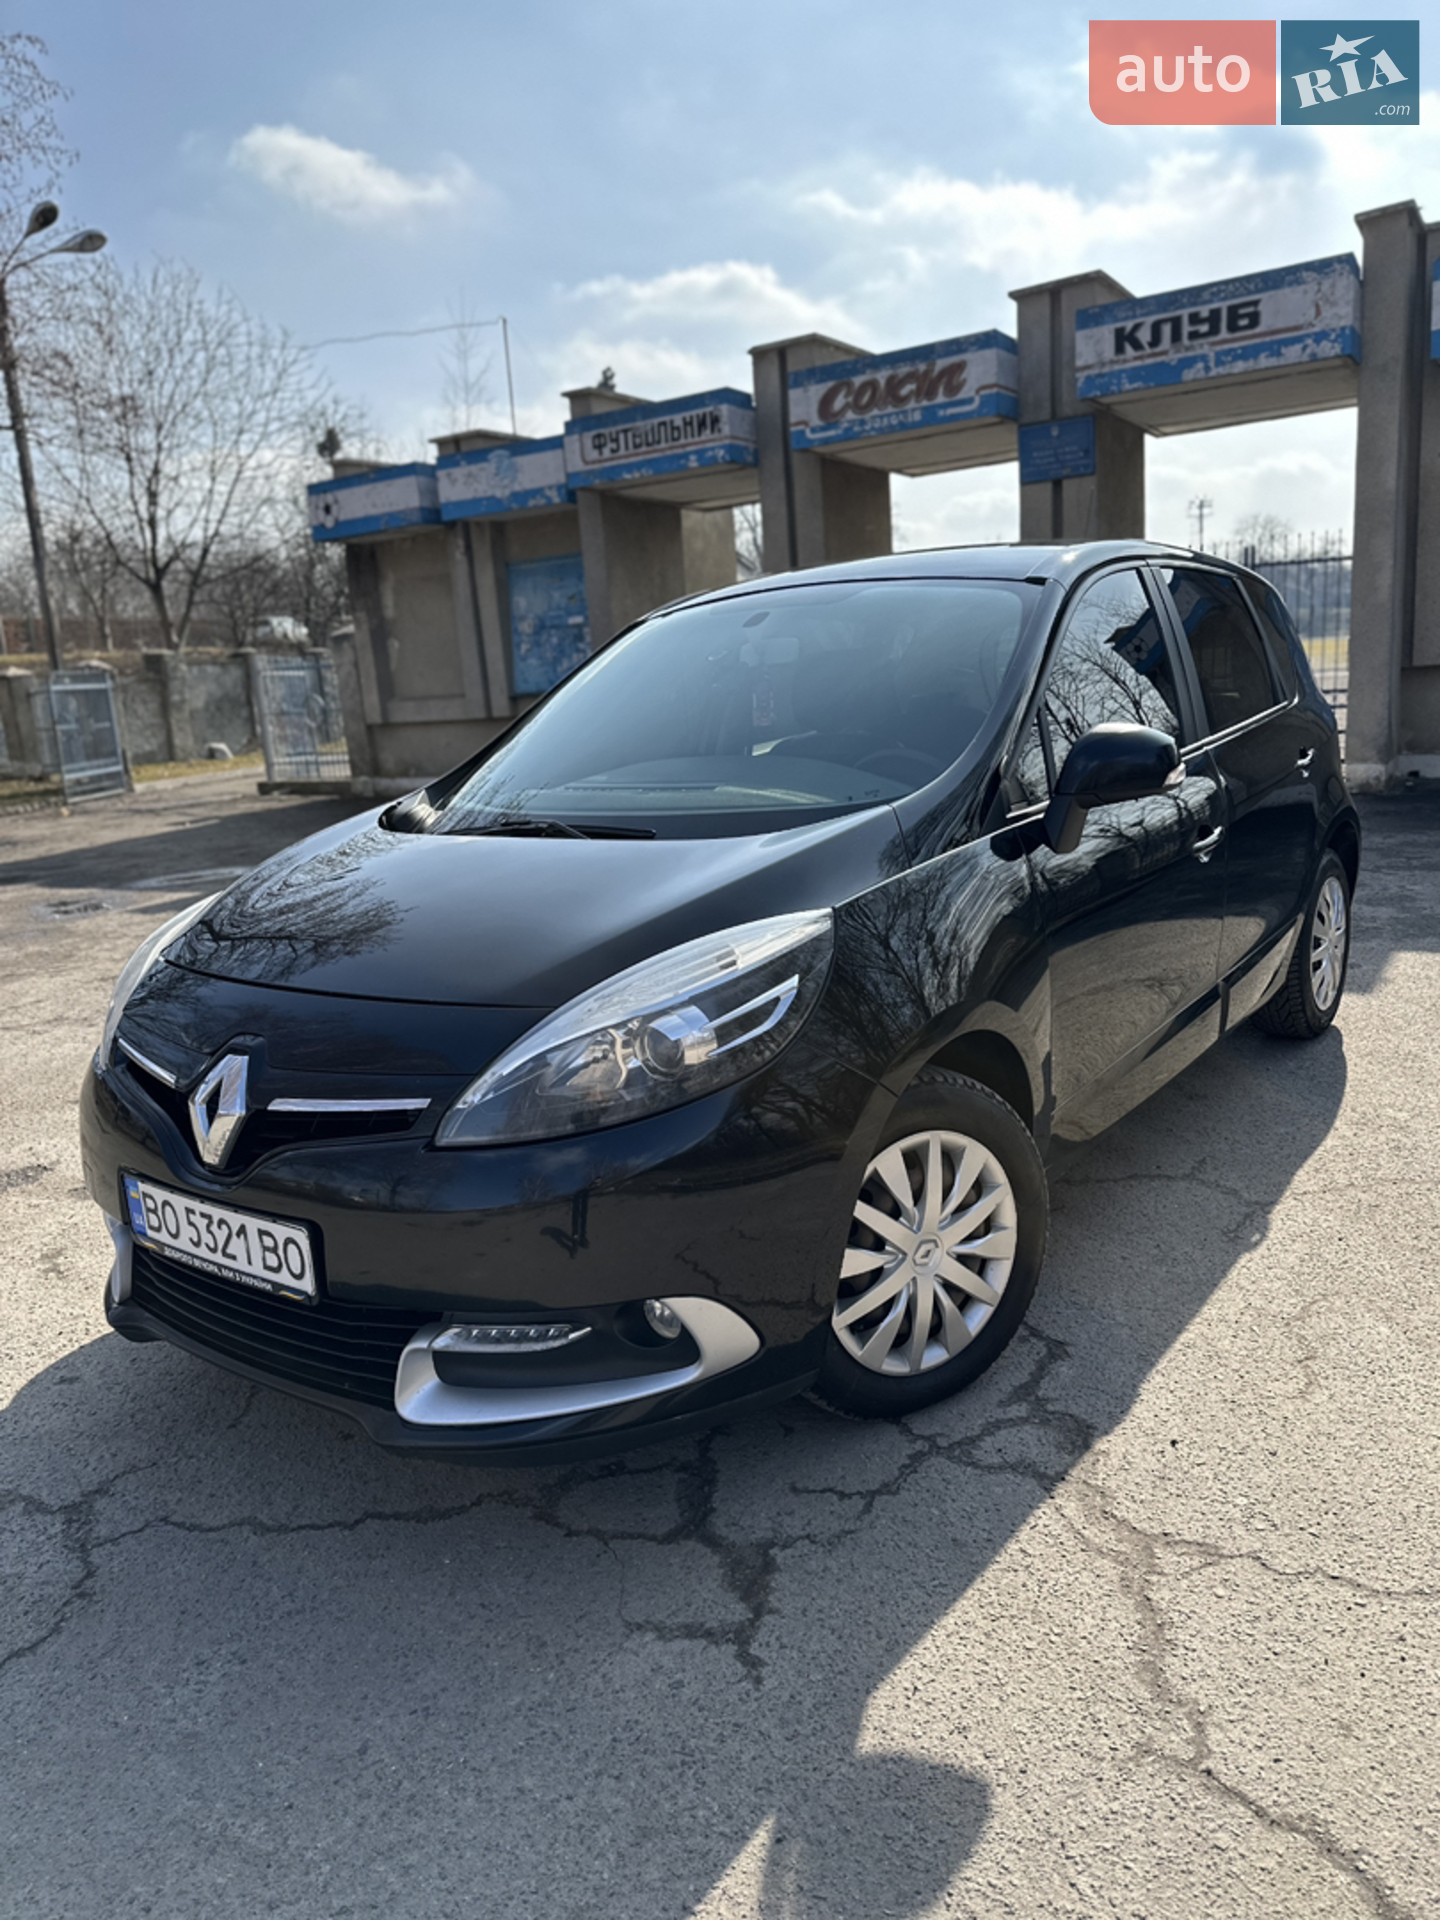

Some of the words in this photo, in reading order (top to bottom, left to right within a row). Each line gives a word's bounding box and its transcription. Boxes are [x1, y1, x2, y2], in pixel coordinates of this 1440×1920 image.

[1114, 298, 1262, 357] КЛУБ
[142, 1191, 180, 1240] BO
[185, 1206, 252, 1266] 5321
[257, 1228, 306, 1281] BO
